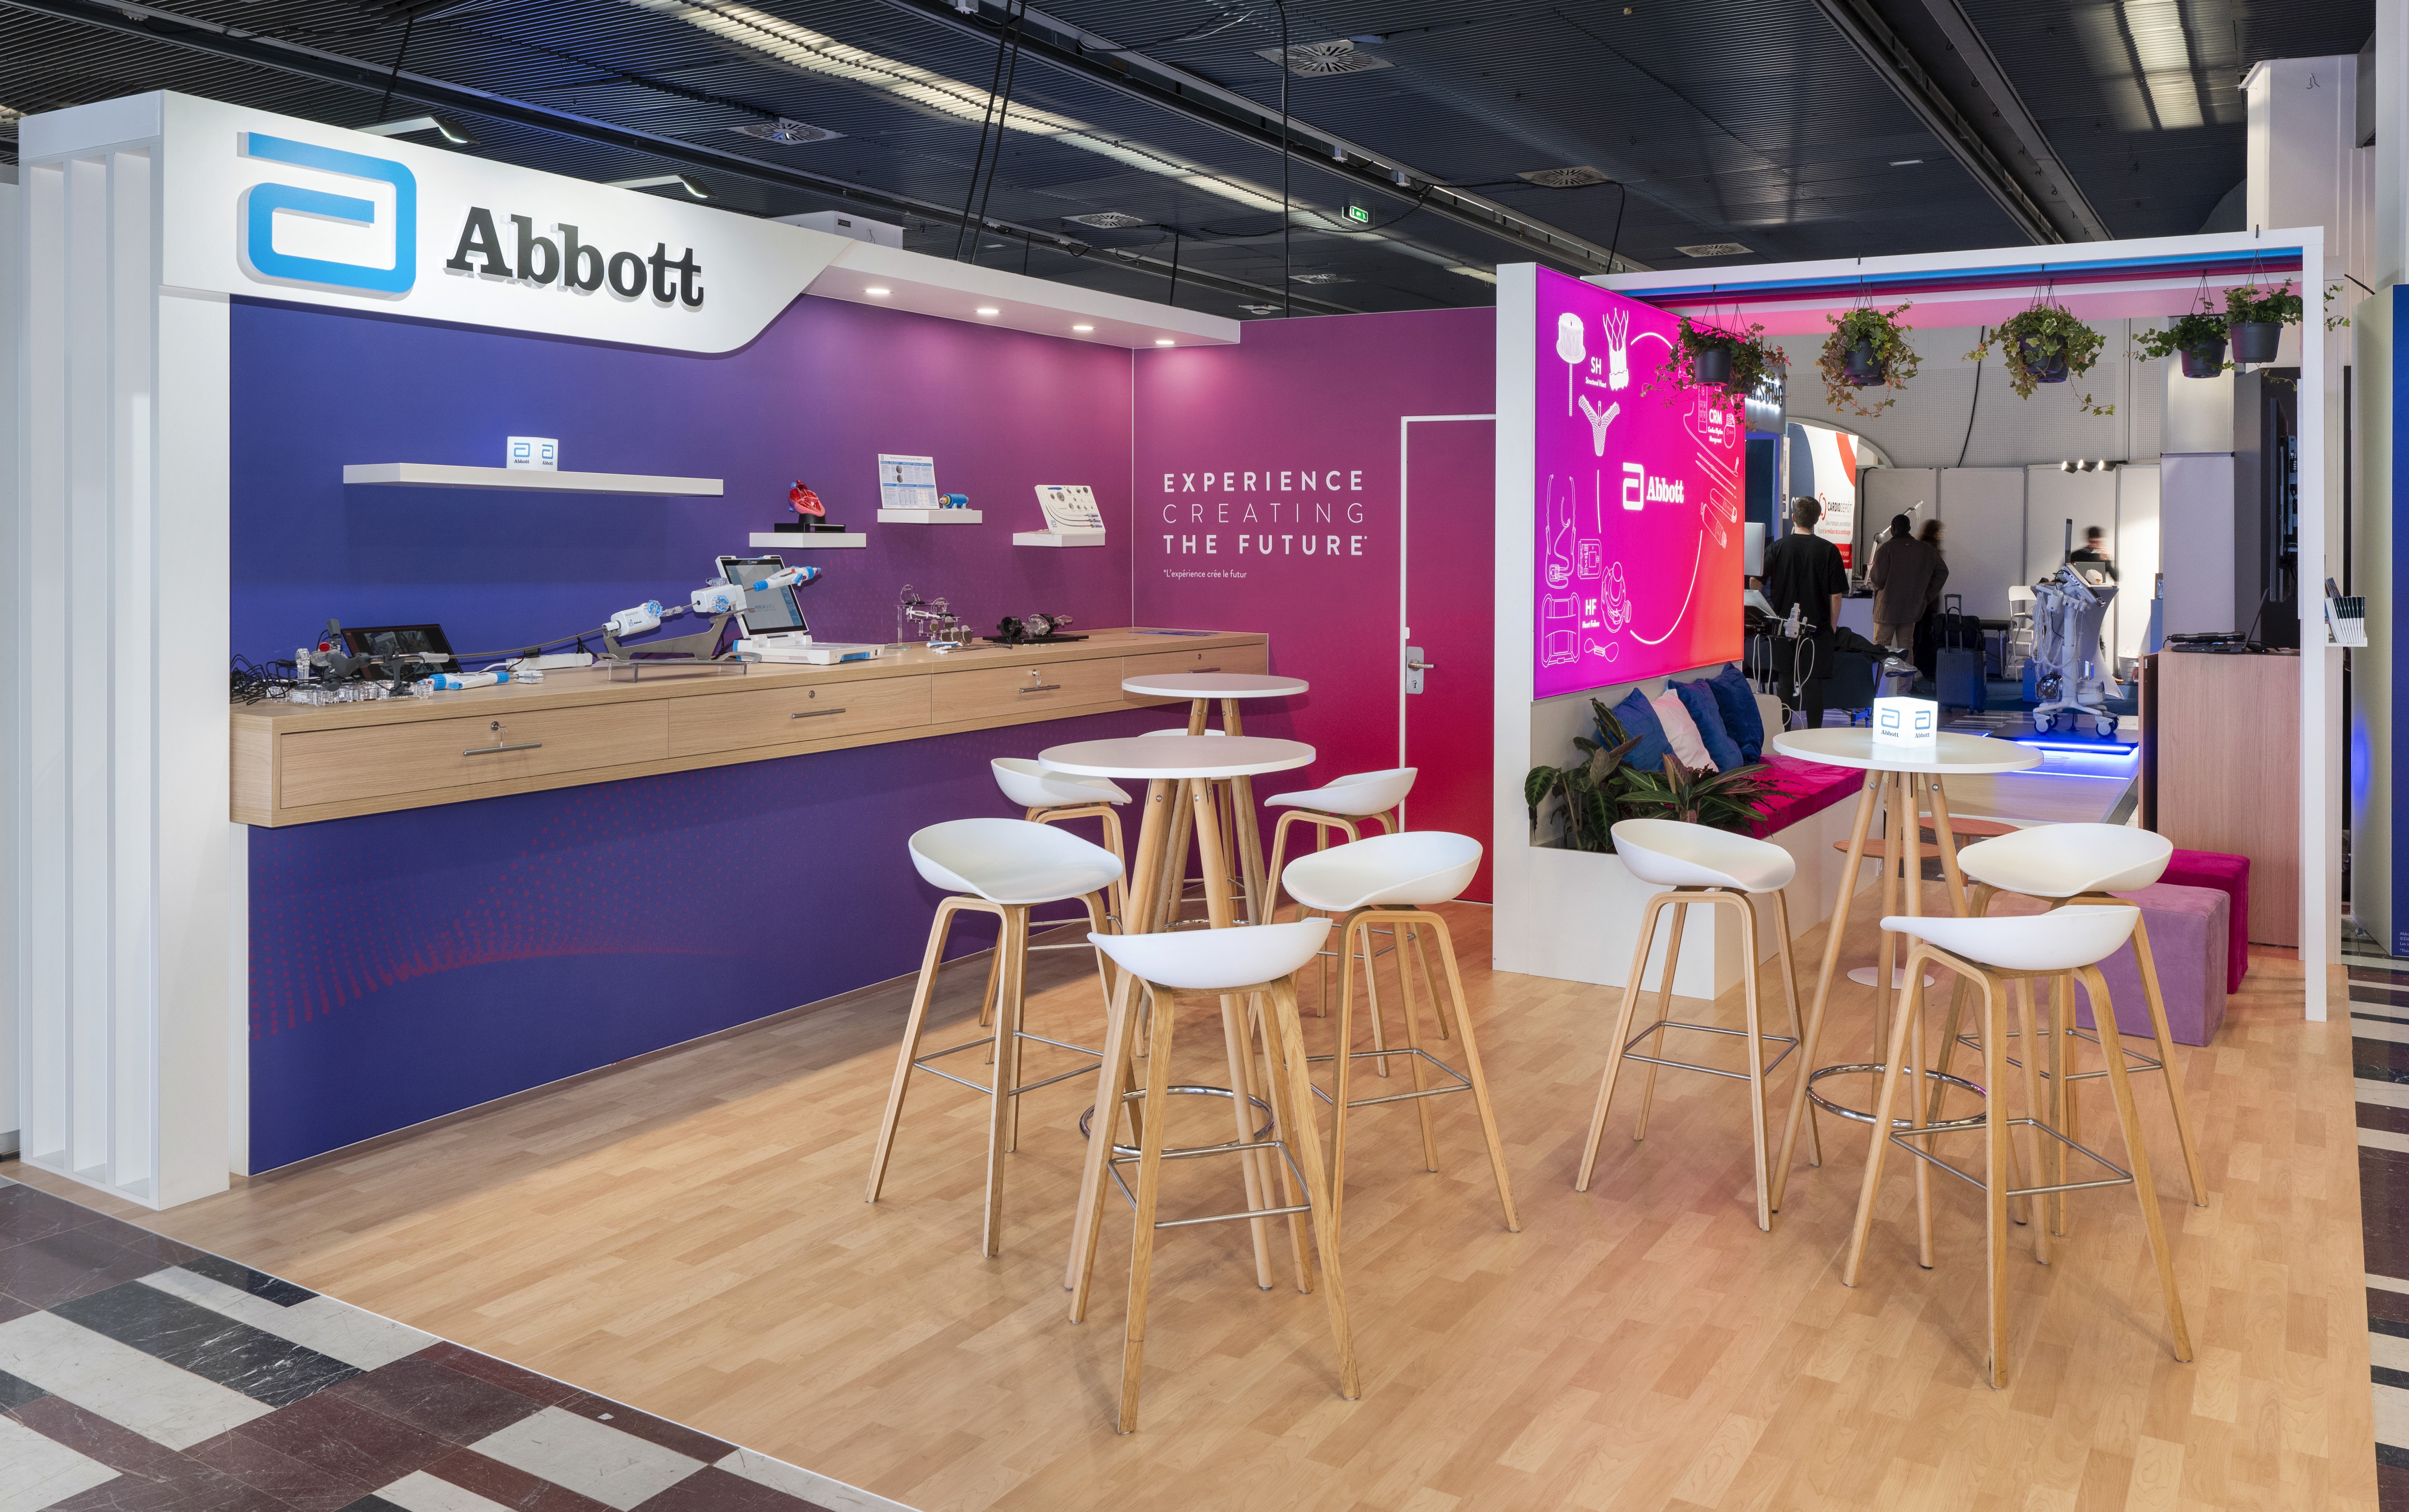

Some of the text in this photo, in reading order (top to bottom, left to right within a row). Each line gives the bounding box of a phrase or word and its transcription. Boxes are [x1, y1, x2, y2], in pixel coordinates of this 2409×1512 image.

[446, 206, 704, 307] Abbott
[1591, 356, 1602, 375] SH
[1709, 409, 1722, 425] CRM
[1164, 471, 1363, 492] EXPERIENCE
[1646, 476, 1684, 504] Abbott
[1163, 503, 1363, 524] CREATING
[1163, 535, 1217, 554] THE
[1207, 569, 1221, 577] crée
[1223, 569, 1229, 577] le
[1230, 569, 1247, 578] futur
[1585, 599, 1597, 616] HF
[1881, 729, 1899, 737] Abbott
